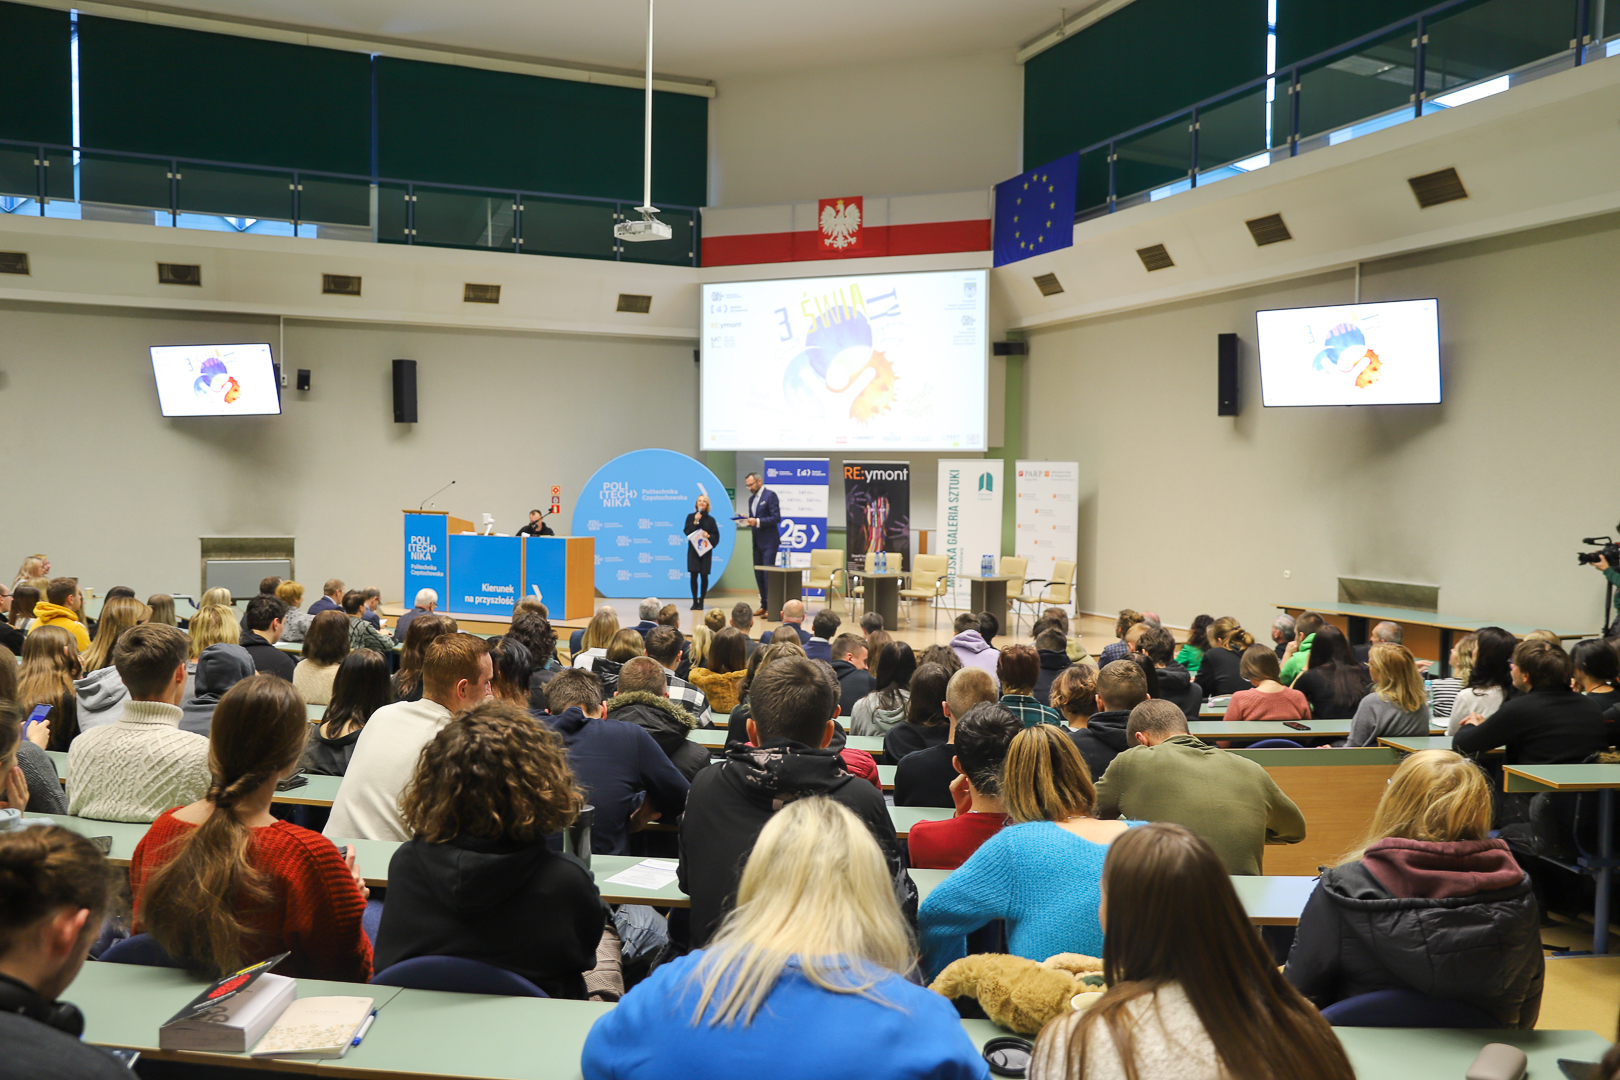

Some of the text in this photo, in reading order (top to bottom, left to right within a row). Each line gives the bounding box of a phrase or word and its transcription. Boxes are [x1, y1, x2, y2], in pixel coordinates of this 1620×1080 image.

[844, 466, 909, 483] RE:ymont
[603, 481, 629, 492] POLI
[948, 469, 960, 503] SZTUKI
[603, 499, 631, 508] NIKA
[946, 505, 959, 545] GALERIA
[779, 518, 807, 549] 25
[410, 535, 431, 544] POLI
[410, 552, 432, 561] NIKA
[481, 583, 514, 593] Kierunek
[464, 595, 474, 603] na
